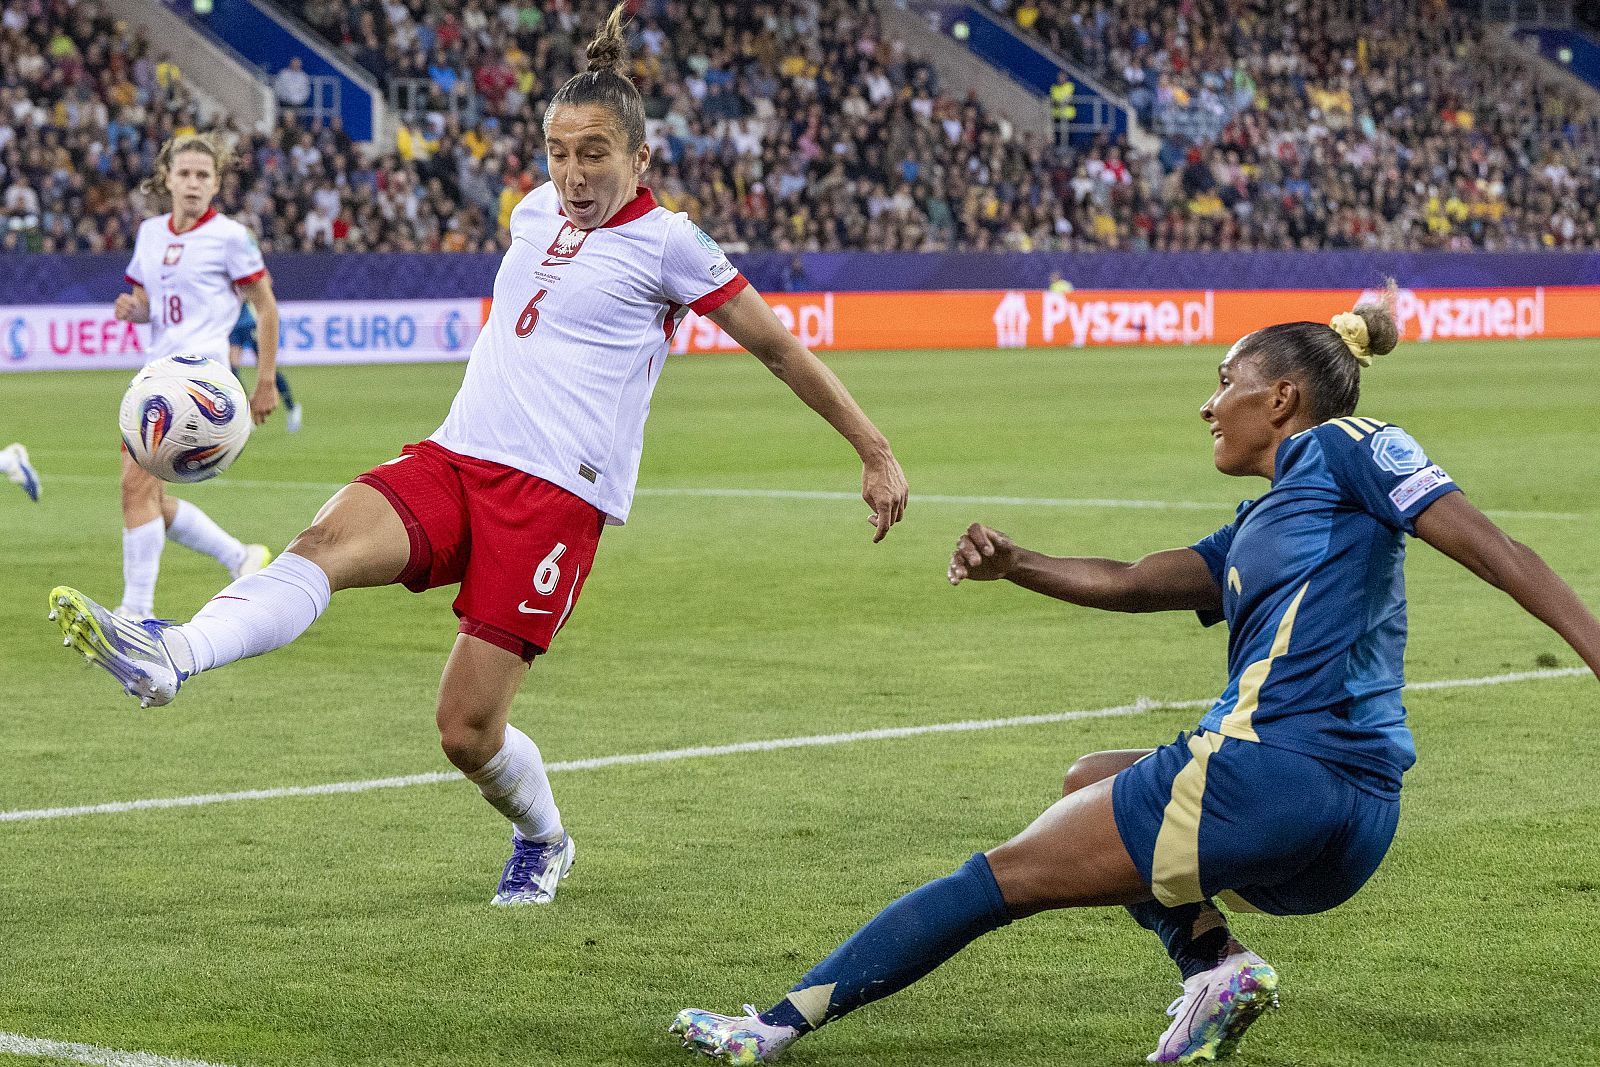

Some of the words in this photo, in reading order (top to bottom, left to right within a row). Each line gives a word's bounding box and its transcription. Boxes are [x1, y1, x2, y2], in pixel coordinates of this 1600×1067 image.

[49, 319, 142, 354] UEFA
[324, 314, 417, 349] EURO
[161, 295, 183, 325] 18
[515, 289, 548, 338] 6
[1042, 289, 1214, 347] Pyszne.pl
[1396, 287, 1545, 341] Pyszne.pl
[533, 542, 567, 595] 6
